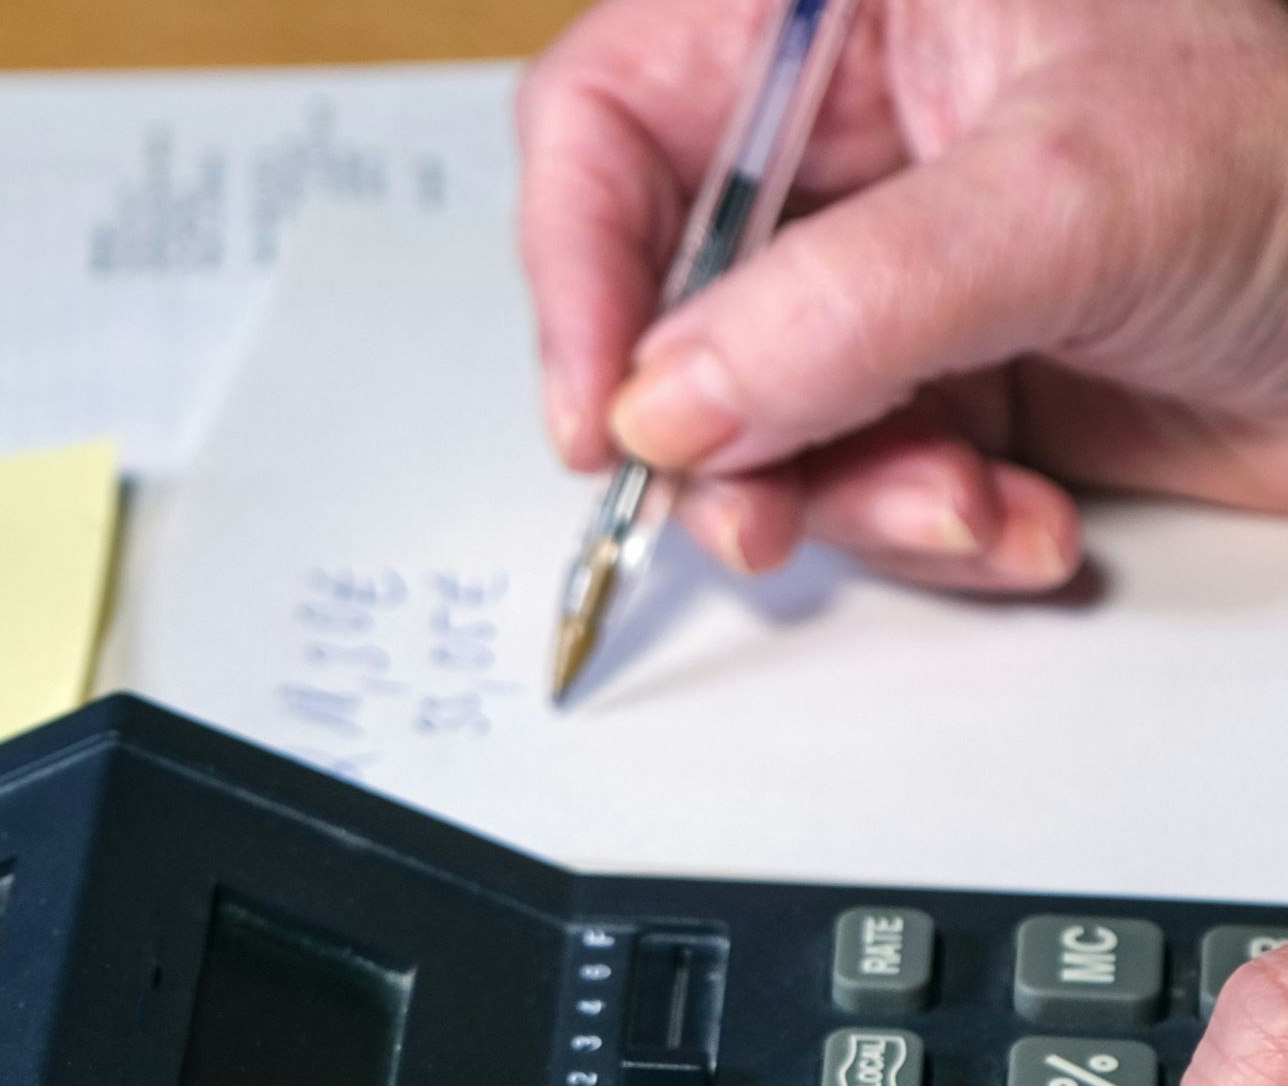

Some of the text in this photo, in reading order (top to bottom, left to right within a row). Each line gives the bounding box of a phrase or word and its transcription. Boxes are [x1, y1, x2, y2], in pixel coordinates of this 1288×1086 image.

[583, 927, 616, 948] F
[861, 915, 905, 976] RATE
[1059, 925, 1118, 984] MC
[571, 1034, 604, 1052] 3
